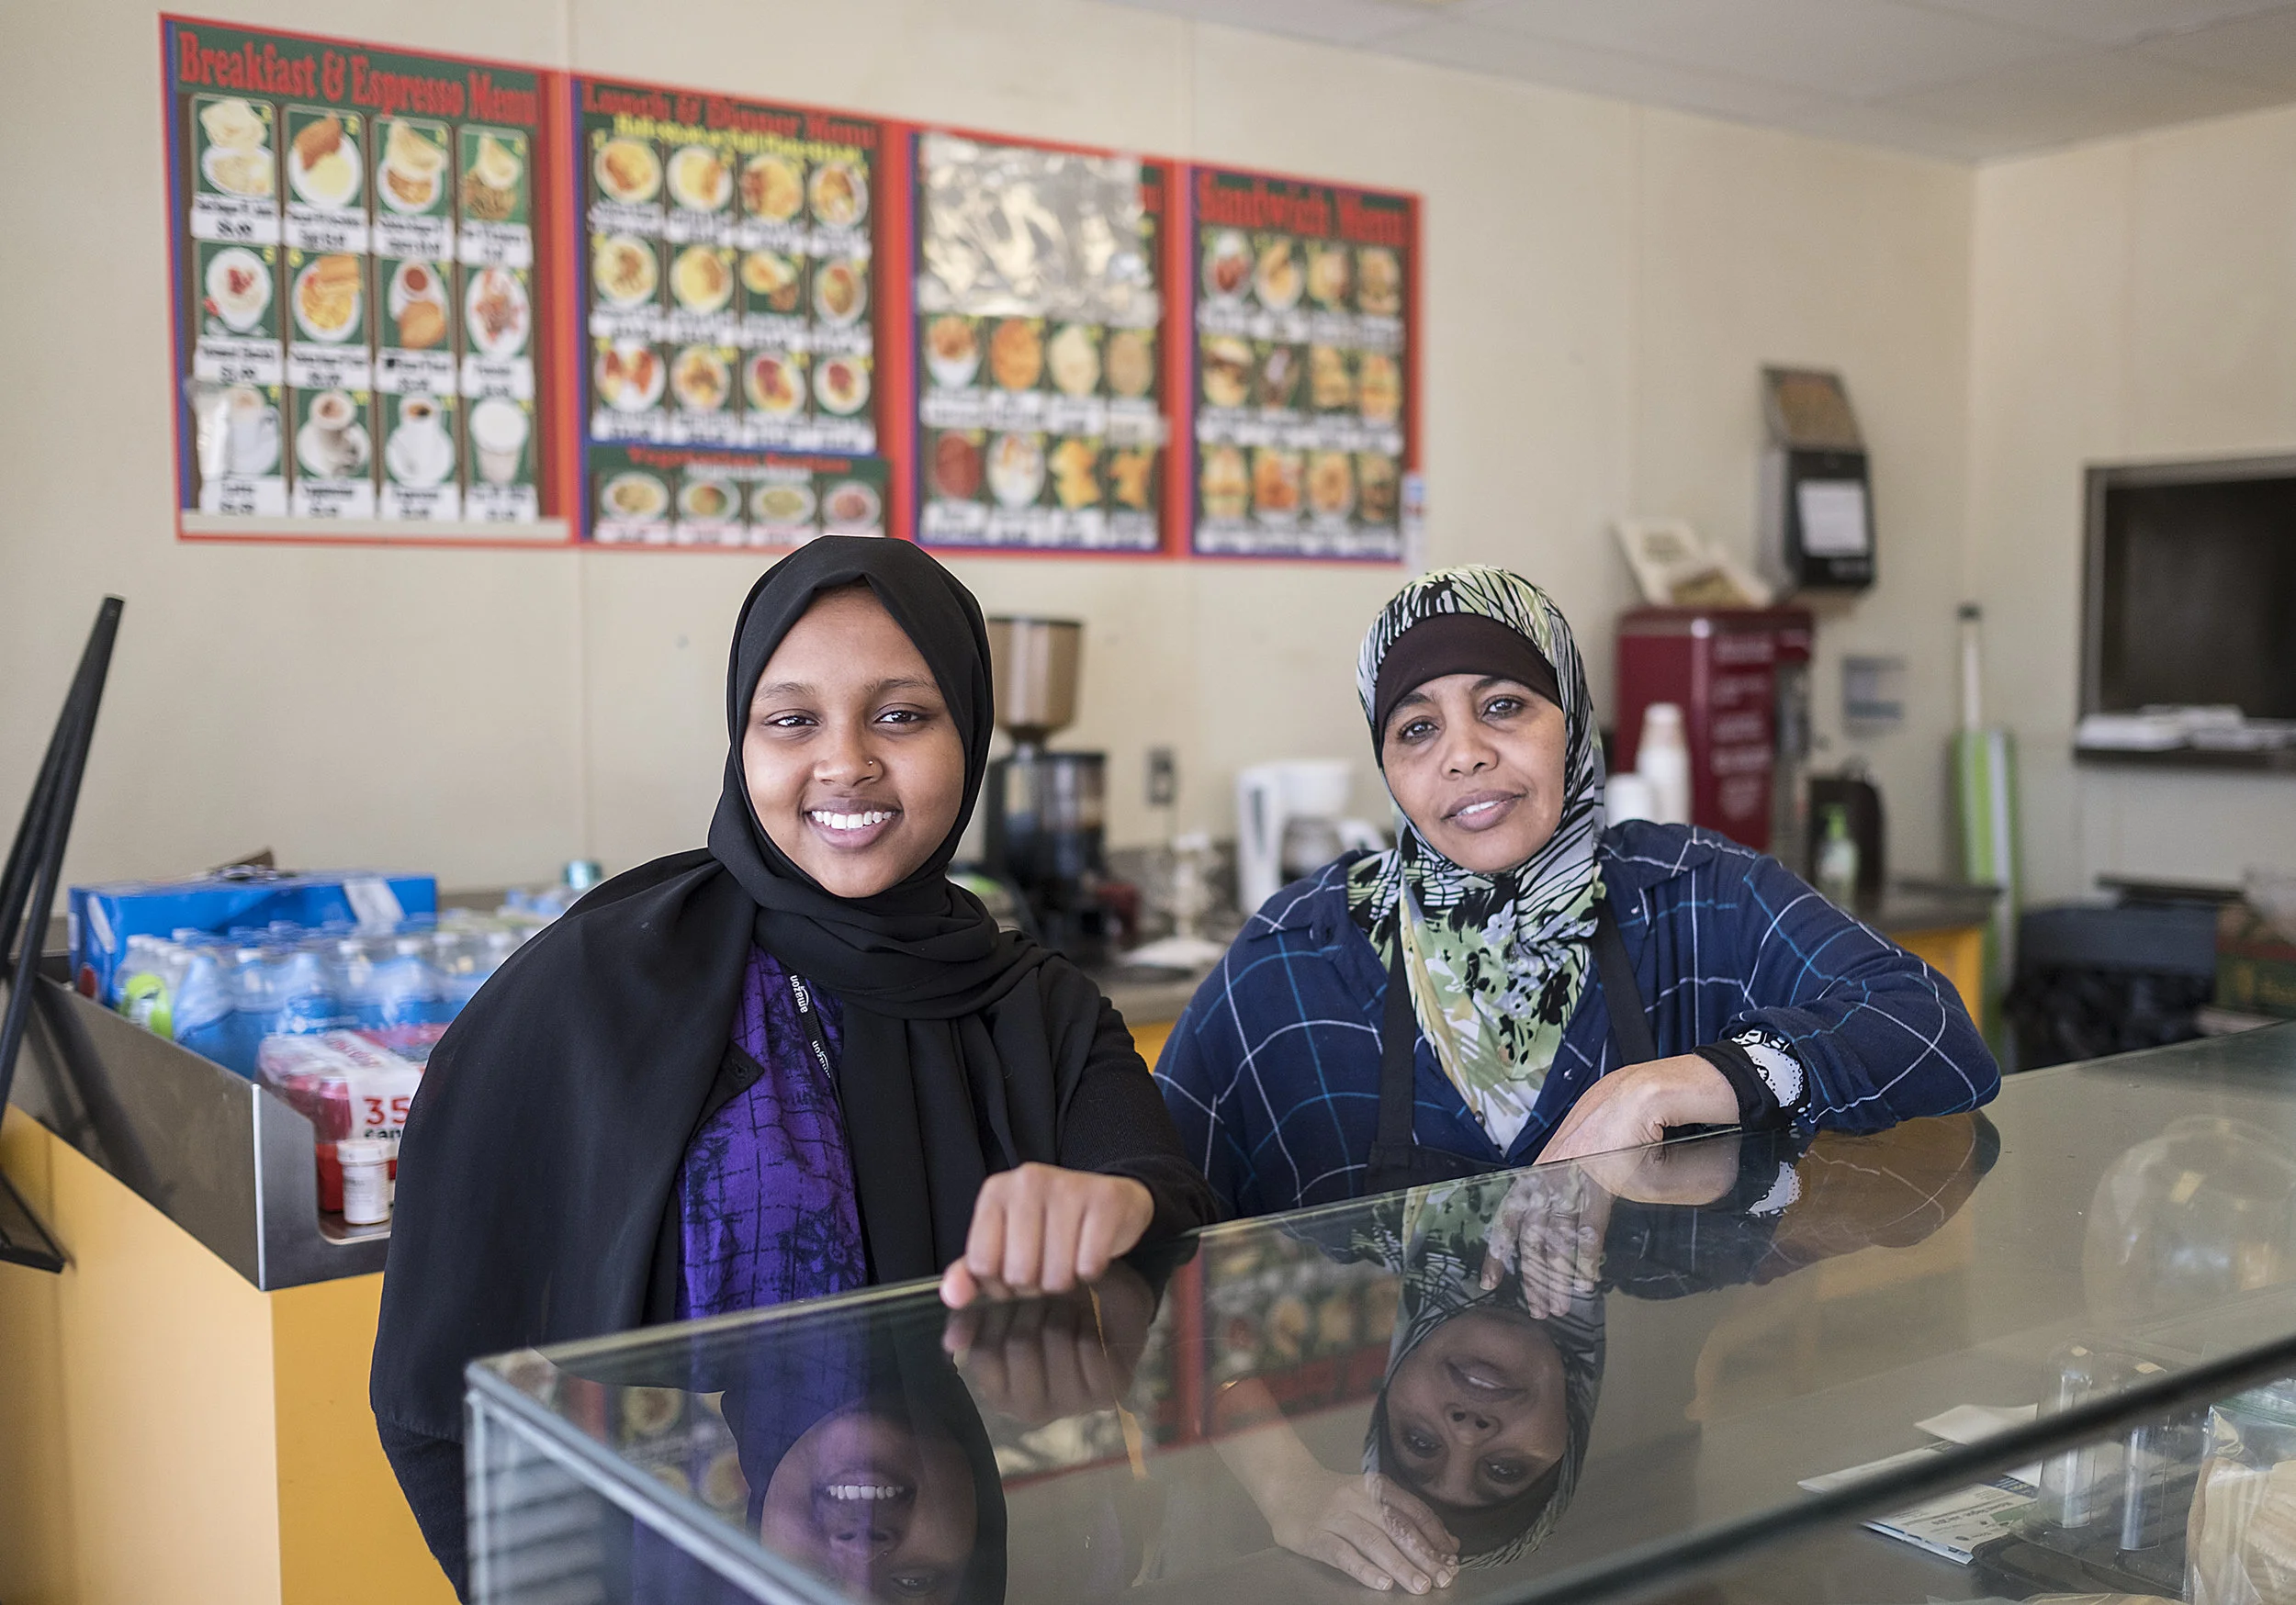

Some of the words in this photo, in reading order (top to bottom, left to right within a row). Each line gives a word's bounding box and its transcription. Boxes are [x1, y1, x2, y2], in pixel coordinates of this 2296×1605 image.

[179, 31, 318, 99] Breakfast
[322, 50, 346, 103] &
[350, 54, 465, 119] Espresso
[468, 70, 538, 125] Menu
[790, 975, 808, 1014] amazon
[812, 1040, 831, 1079] mazon
[364, 1097, 410, 1125] 35
[365, 1128, 402, 1140] can
